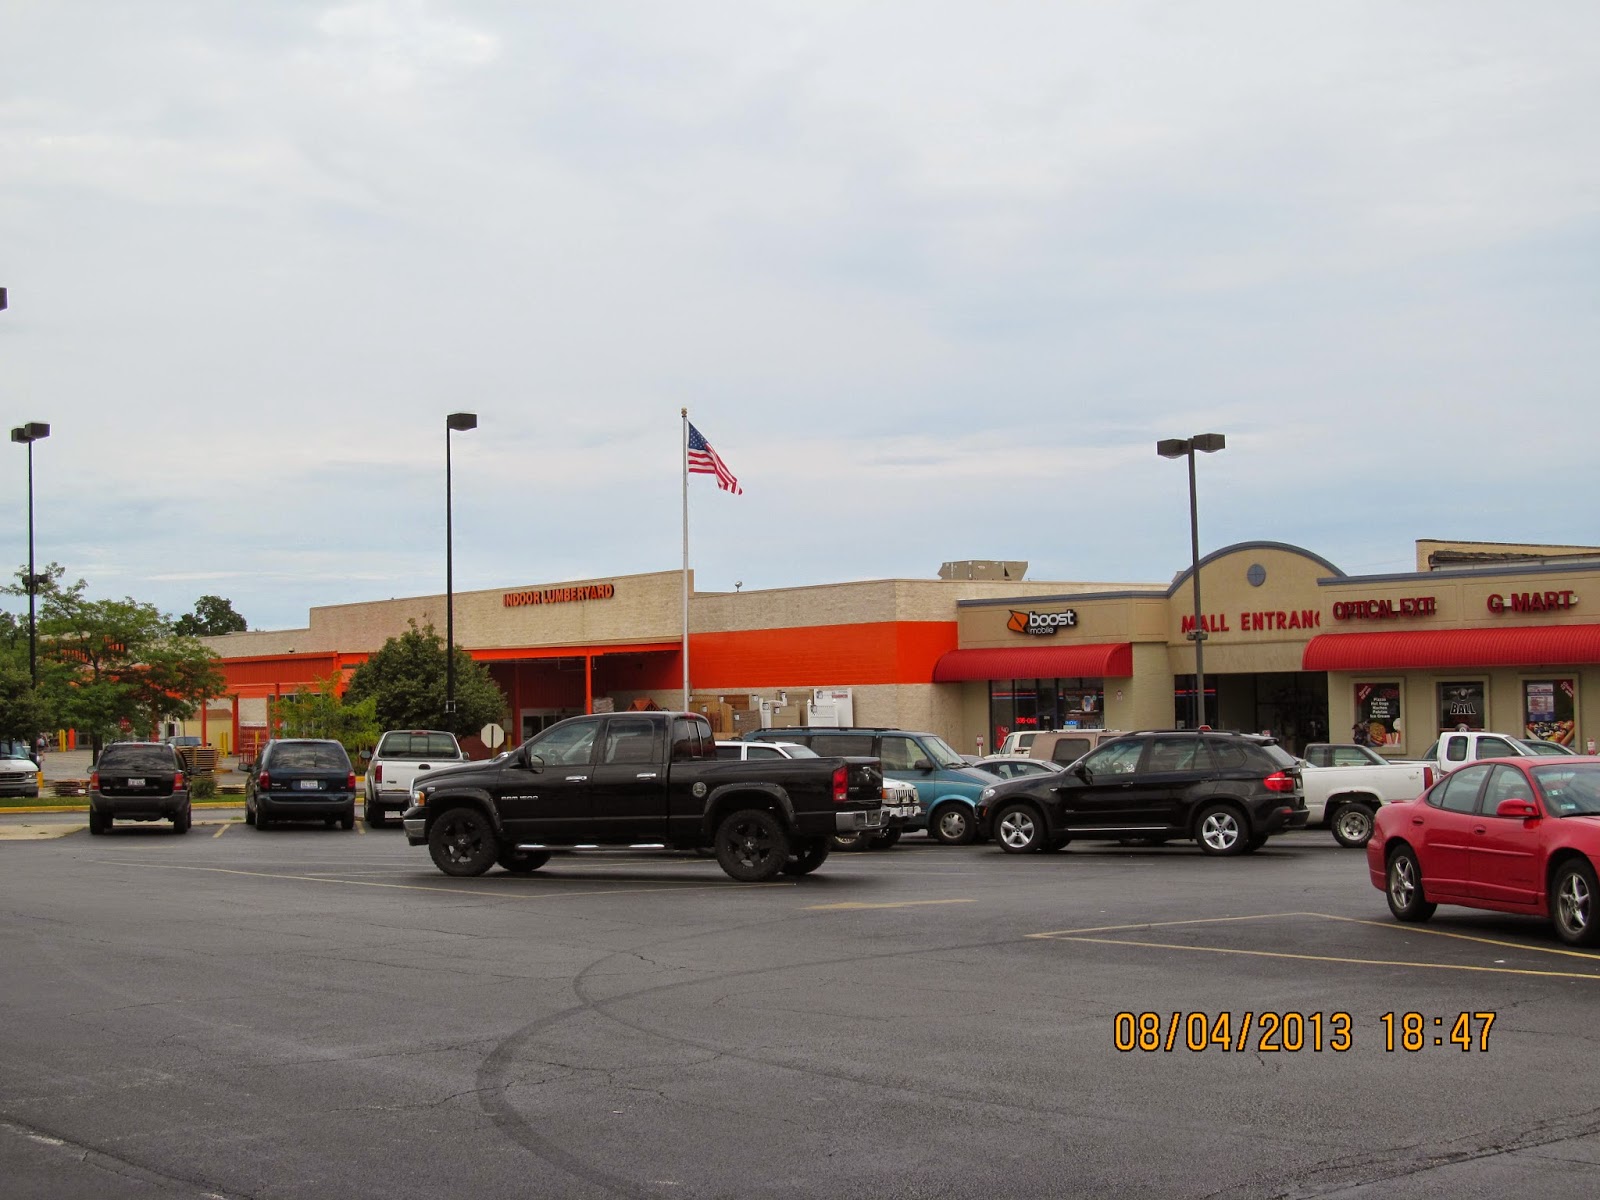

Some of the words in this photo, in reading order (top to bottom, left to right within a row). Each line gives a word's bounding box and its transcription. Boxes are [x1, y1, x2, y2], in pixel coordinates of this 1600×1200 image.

[503, 591, 541, 607] INDOOR
[542, 583, 614, 603] LUMBERYARD
[1487, 594, 1504, 613] G
[1511, 590, 1574, 612] MART
[1029, 610, 1074, 627] boost
[1333, 600, 1397, 620] OPTICAL
[1030, 626, 1054, 634] mobile
[1181, 613, 1229, 633] MALL
[1450, 701, 1476, 714] BALL
